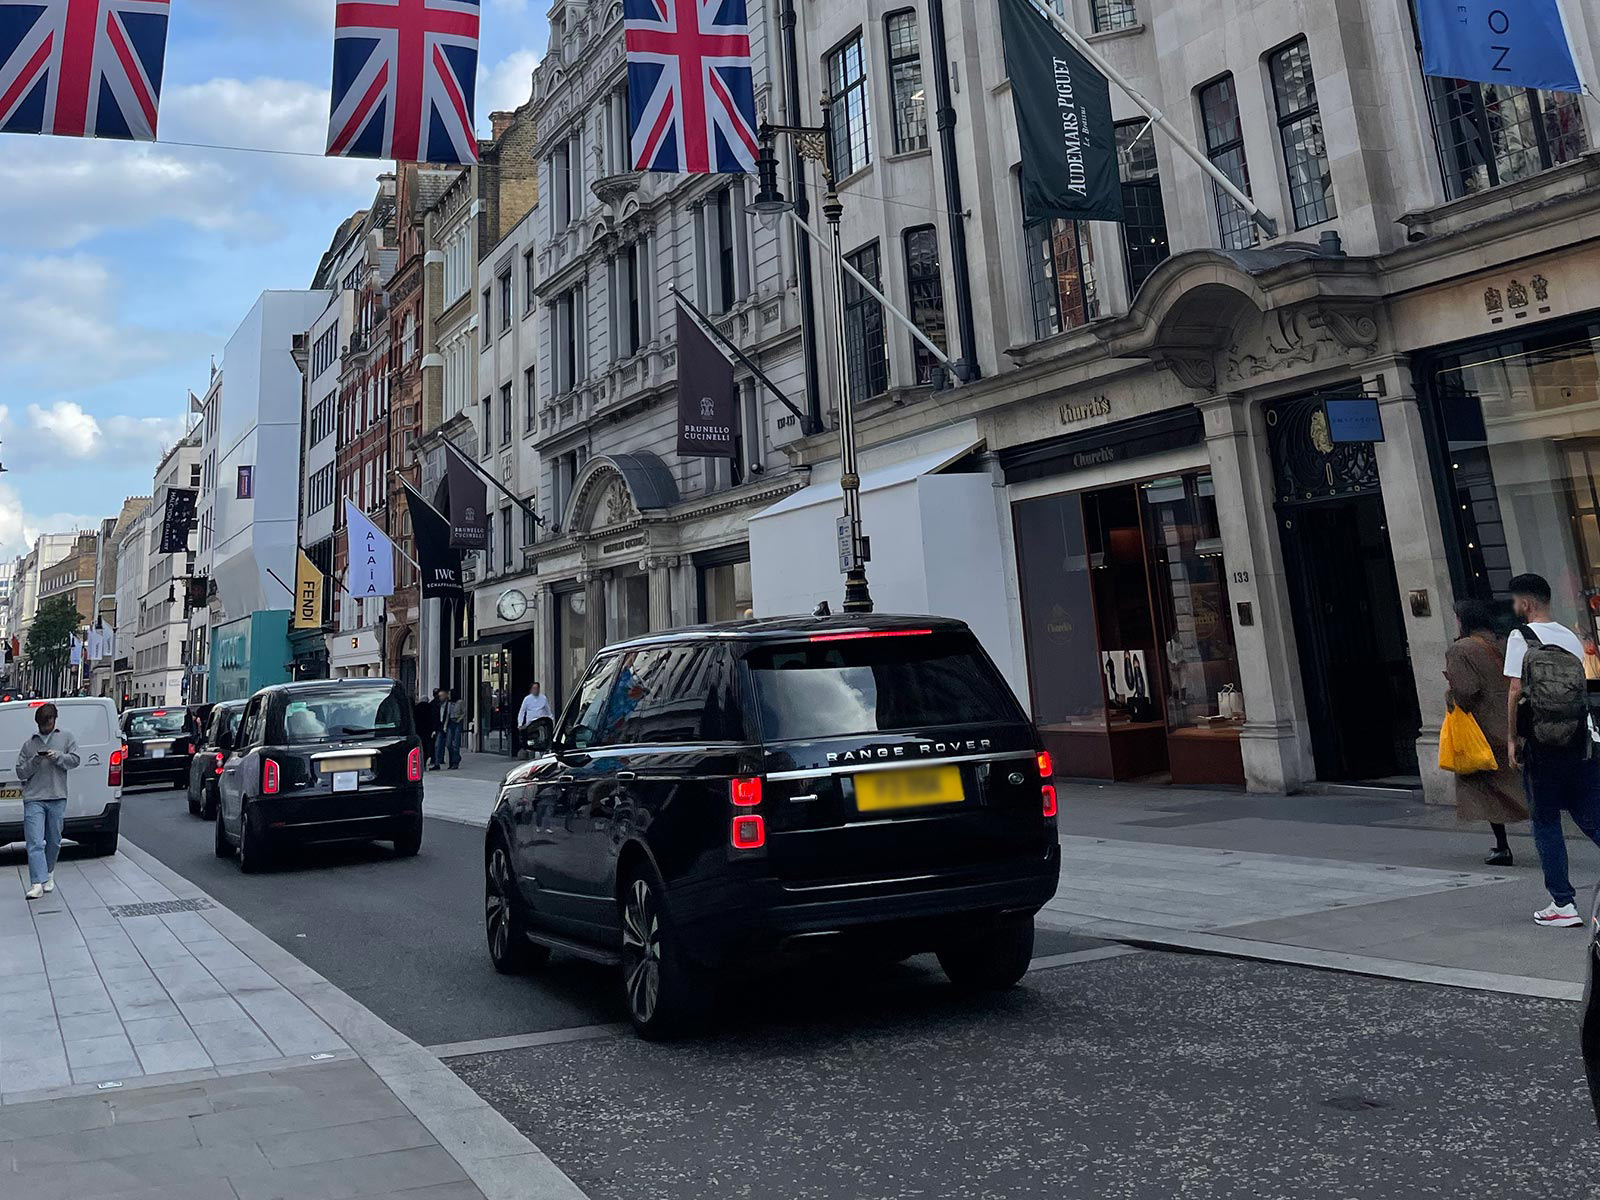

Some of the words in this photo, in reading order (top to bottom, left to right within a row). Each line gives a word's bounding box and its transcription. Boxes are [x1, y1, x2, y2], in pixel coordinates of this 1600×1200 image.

[1052, 56, 1074, 110] PIGUET
[1083, 136, 1091, 147] Le
[1062, 112, 1087, 197] AUDEMARS
[684, 425, 730, 434] BRUNELLO
[684, 433, 730, 441] CUCINELLI
[366, 531, 376, 593] ALAÏA
[434, 568, 456, 581] IWC
[1233, 571, 1249, 583] 133
[302, 581, 315, 621] FENDI
[826, 746, 904, 762] RANGE
[919, 739, 991, 754] ROVER
